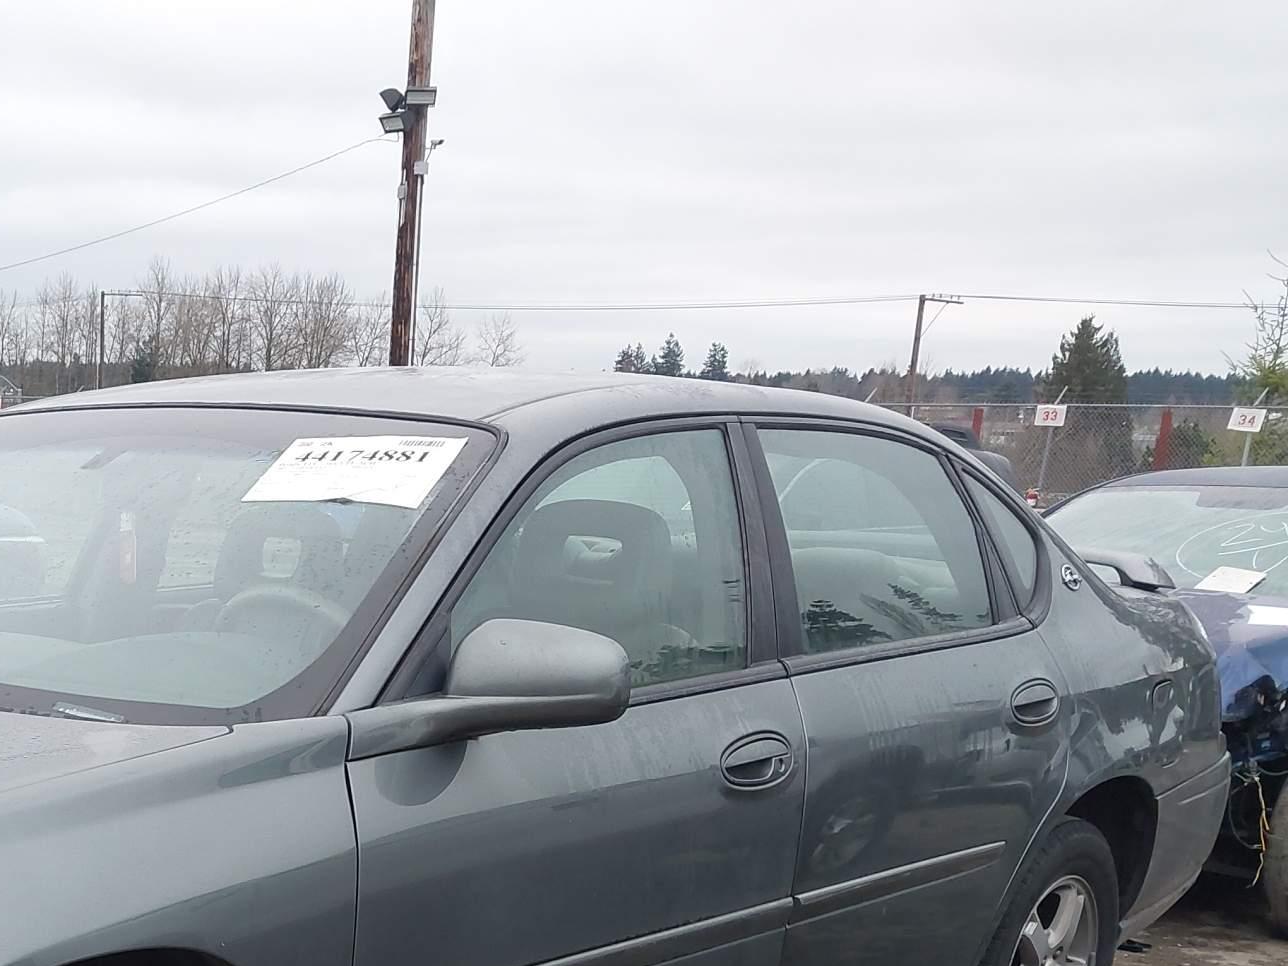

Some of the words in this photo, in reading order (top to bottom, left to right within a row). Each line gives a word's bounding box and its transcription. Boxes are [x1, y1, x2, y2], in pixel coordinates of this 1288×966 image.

[1042, 411, 1058, 421] 33
[1238, 414, 1256, 425] 34
[295, 449, 430, 463] 44174881
